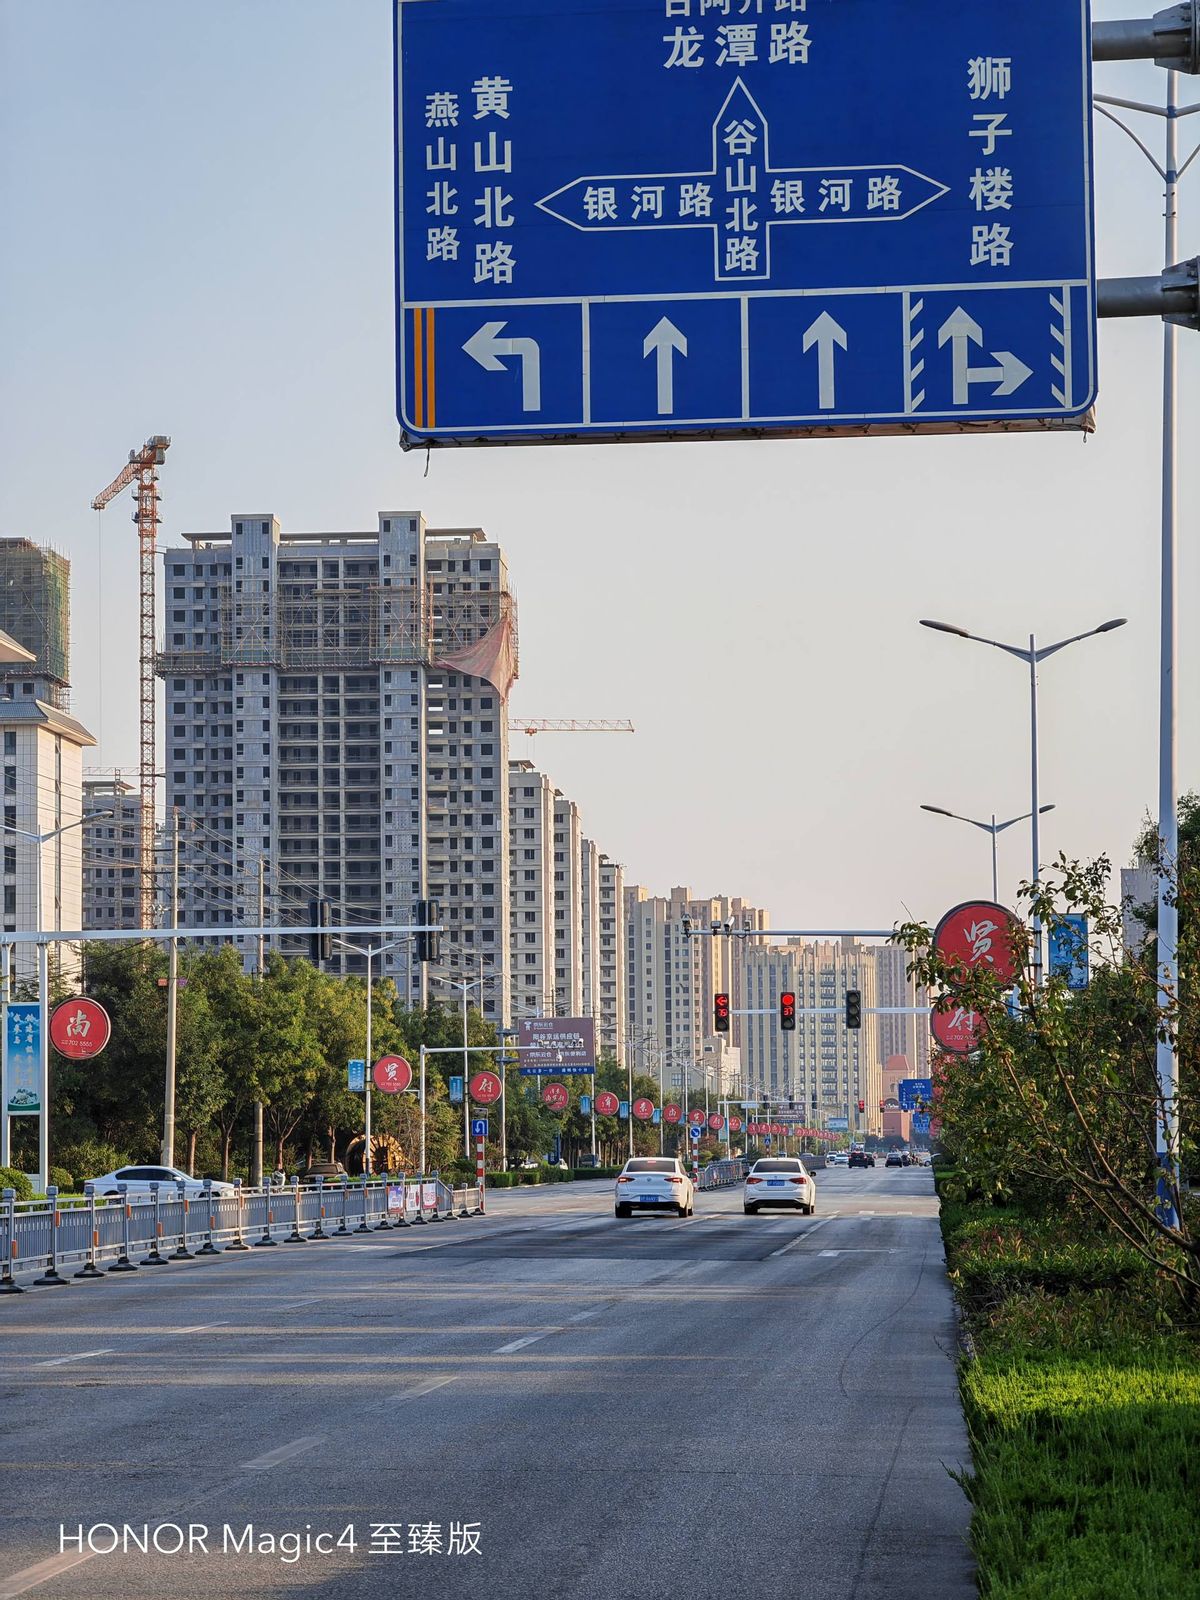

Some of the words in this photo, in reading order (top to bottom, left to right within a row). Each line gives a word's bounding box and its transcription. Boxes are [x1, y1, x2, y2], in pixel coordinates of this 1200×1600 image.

[663, 21, 812, 69] 龙潭路
[425, 92, 460, 261] 燕山北路
[471, 76, 516, 284] 黄山北路
[582, 180, 714, 221] 银河路
[723, 118, 760, 272] 谷山北路
[770, 175, 903, 216] 银河路
[967, 56, 1014, 267] 狮子楼路
[67, 1009, 91, 1037] 尚
